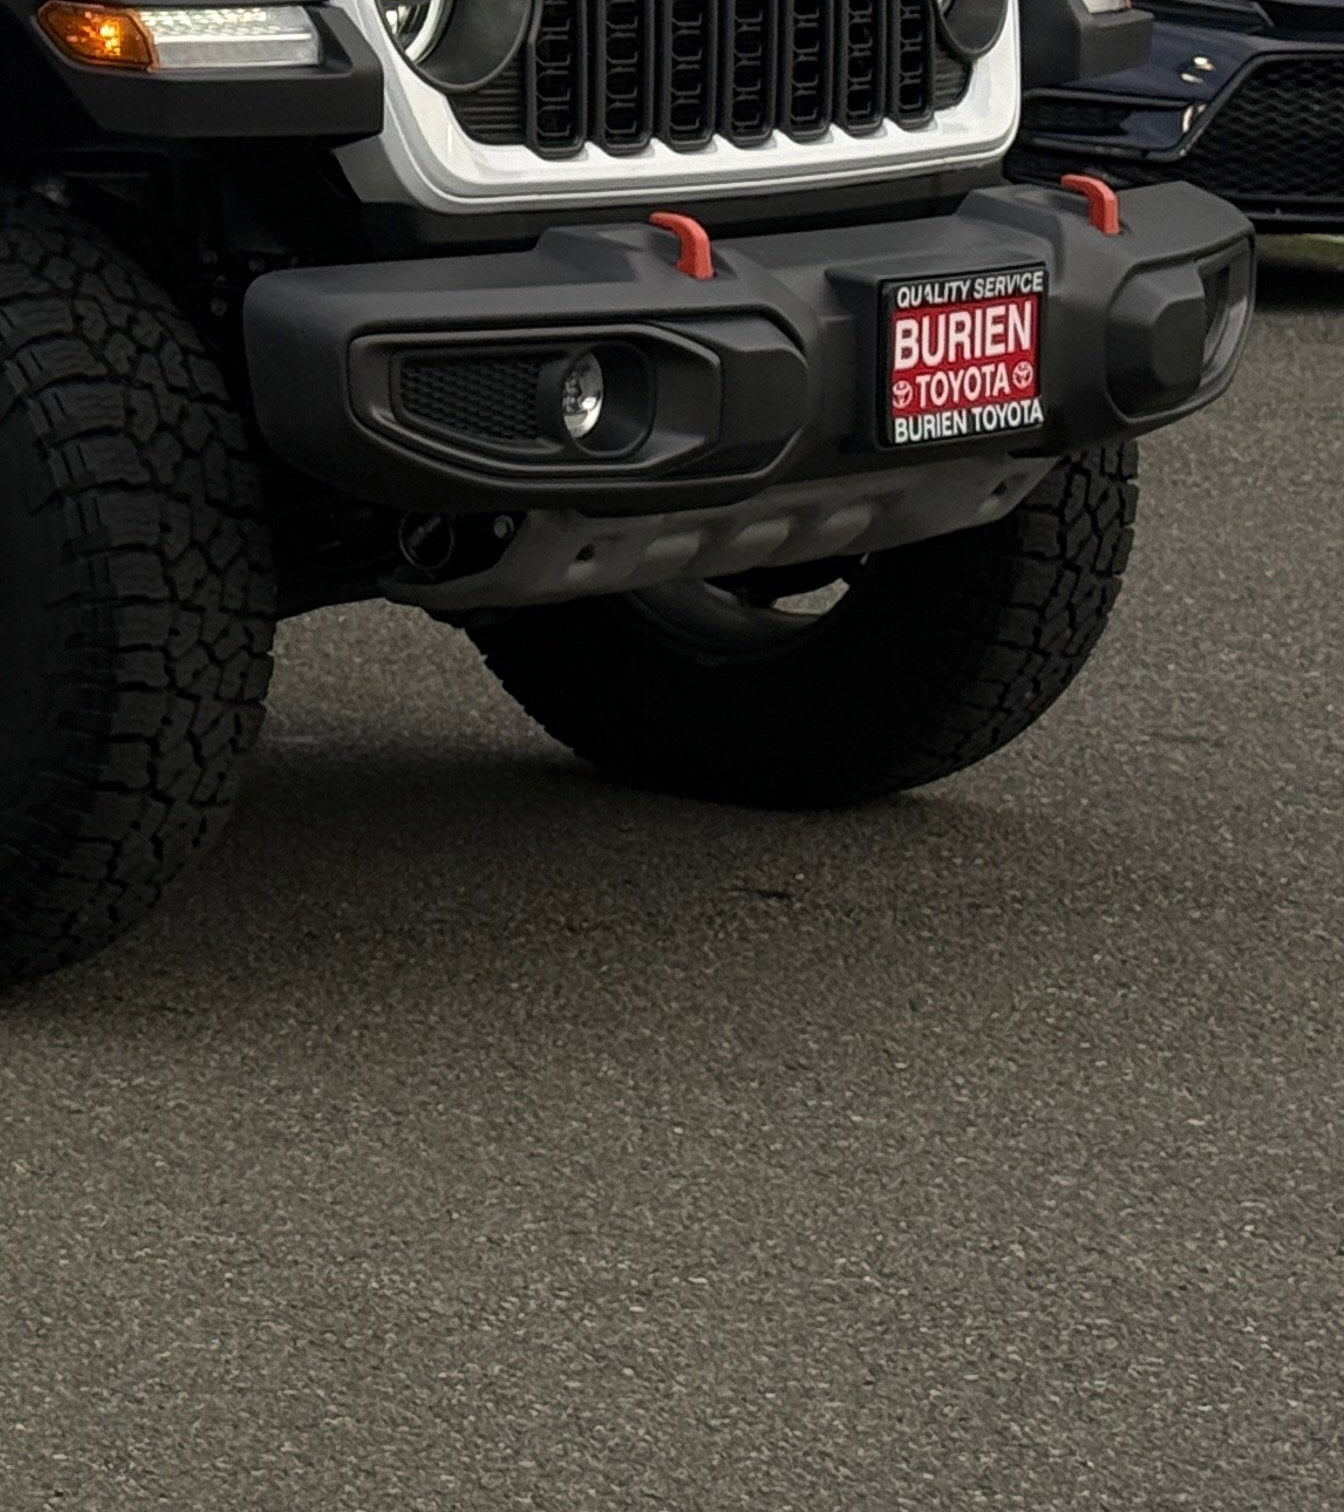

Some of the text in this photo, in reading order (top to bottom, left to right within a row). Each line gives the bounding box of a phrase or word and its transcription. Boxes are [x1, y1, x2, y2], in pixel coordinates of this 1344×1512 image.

[897, 271, 1045, 309] QUALITY SERVICE
[894, 301, 1032, 371] BURIEN
[916, 362, 1011, 409] TOYOTA
[895, 398, 1045, 444] BURIEN TOYOTA
